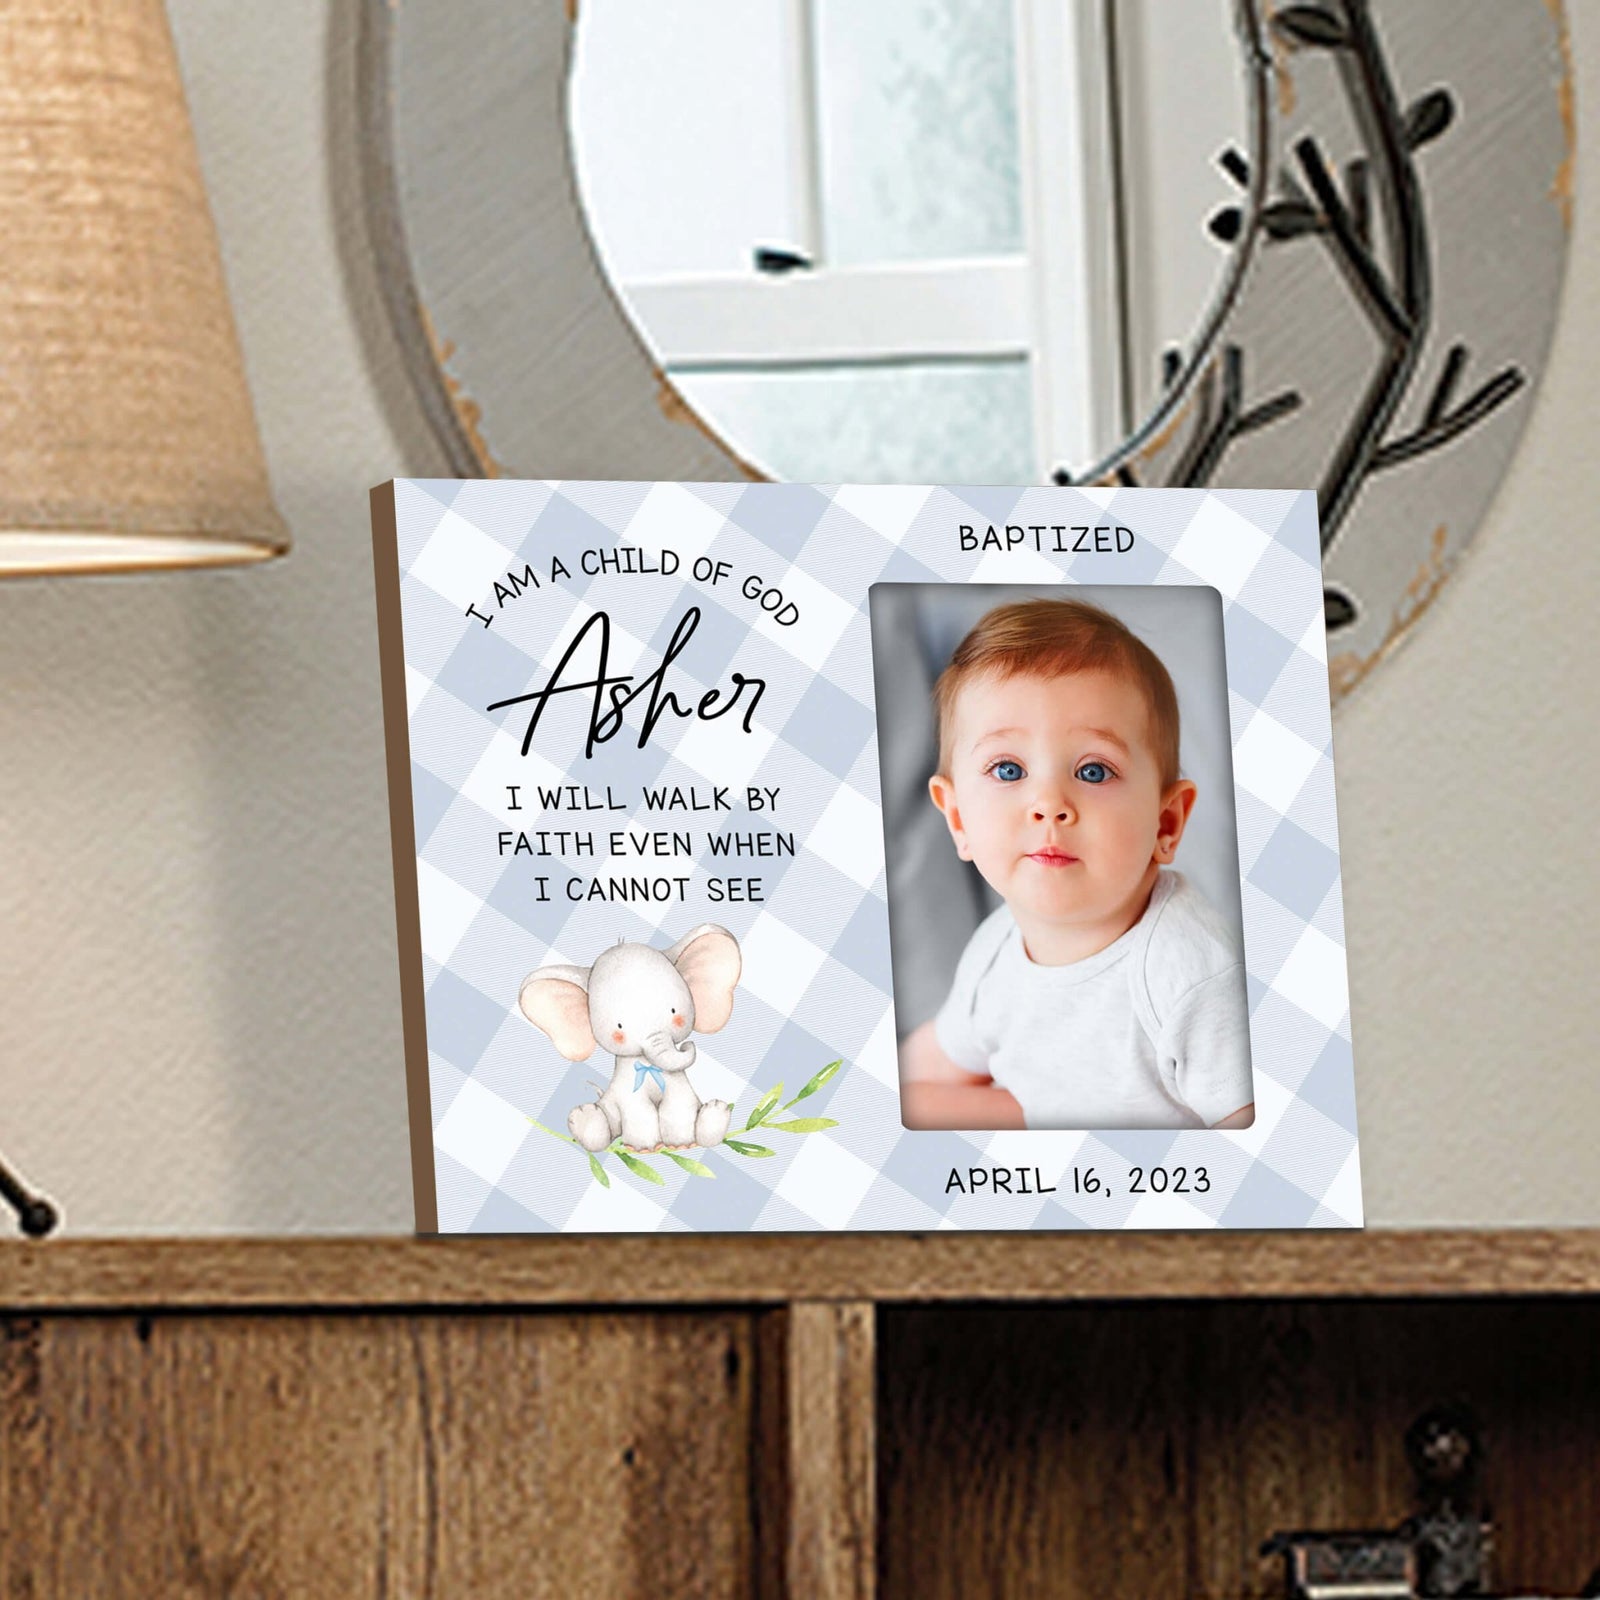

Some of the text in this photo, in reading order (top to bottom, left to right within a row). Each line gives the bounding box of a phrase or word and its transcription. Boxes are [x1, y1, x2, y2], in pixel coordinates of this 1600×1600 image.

[959, 525, 1135, 553] BAPTIZED
[465, 547, 799, 629] I AM A CHILD OF GOD
[486, 606, 766, 760] Asher
[506, 786, 780, 812] I WILL WALK BY
[498, 831, 795, 857] FAITH EVEN WHEN
[534, 877, 765, 902] I CANNOT SEE
[945, 1166, 1211, 1198] APRIL 16, 2023
